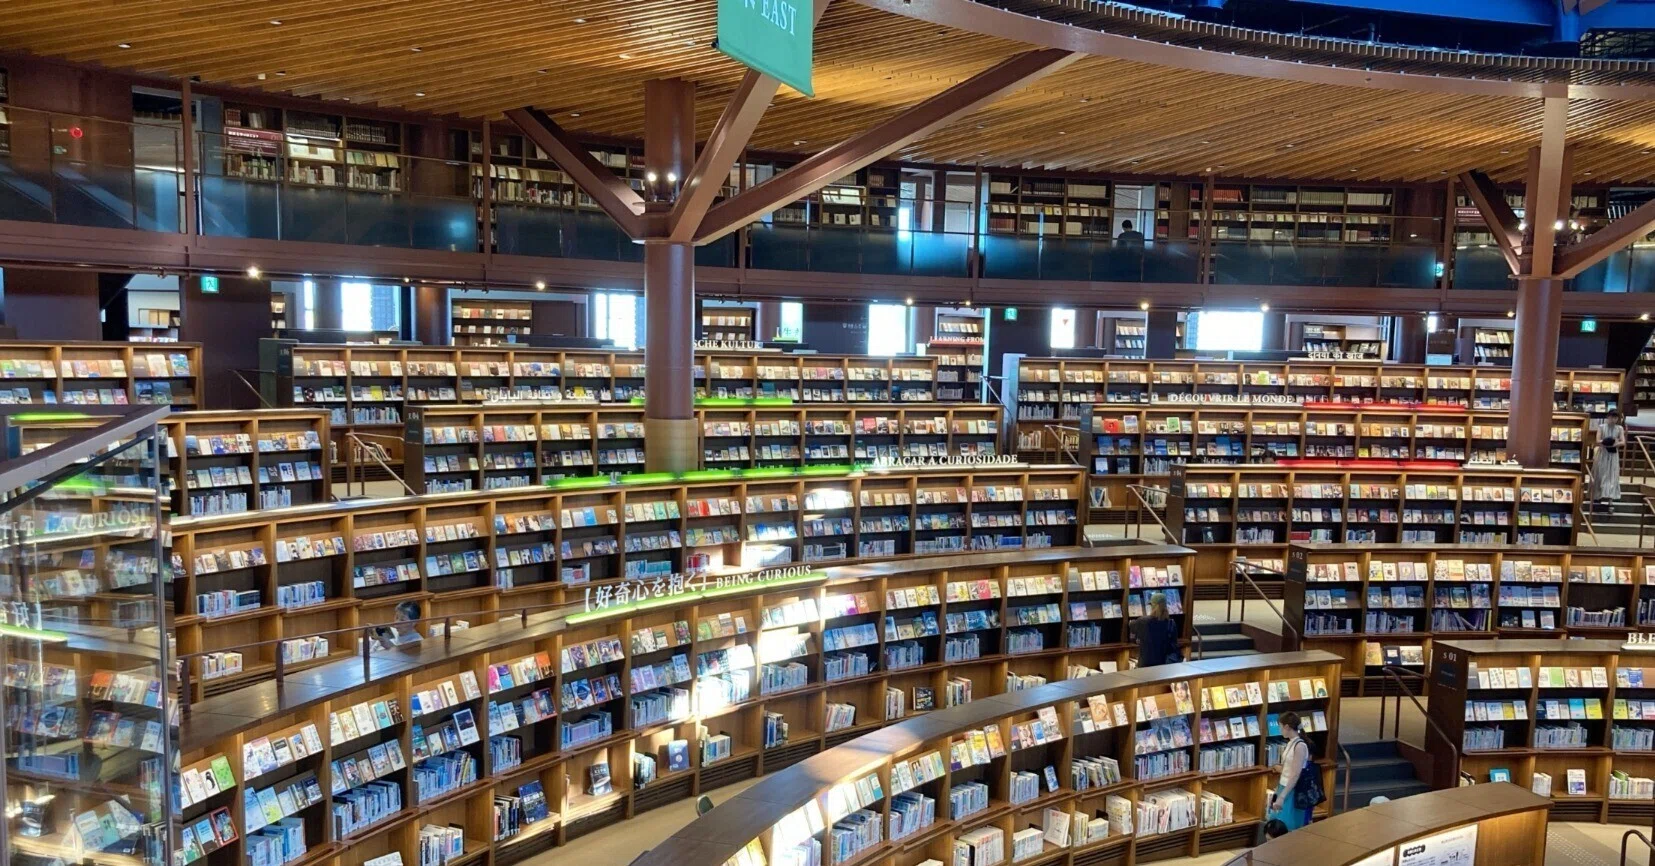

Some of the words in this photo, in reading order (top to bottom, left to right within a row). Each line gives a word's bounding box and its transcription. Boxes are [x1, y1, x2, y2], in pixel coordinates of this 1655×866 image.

[761, 0, 797, 36] EAST
[721, 340, 760, 349] KULTUR
[1171, 392, 1236, 403] DÉCOUVRIR
[1237, 394, 1250, 403] LE
[1252, 394, 1294, 404] MONDE
[873, 456, 926, 468] ABRAÇAR
[928, 456, 936, 465] A
[939, 454, 1018, 465] CURIOSIDADE
[716, 572, 754, 589] BEING
[757, 565, 812, 583] CURIOUS
